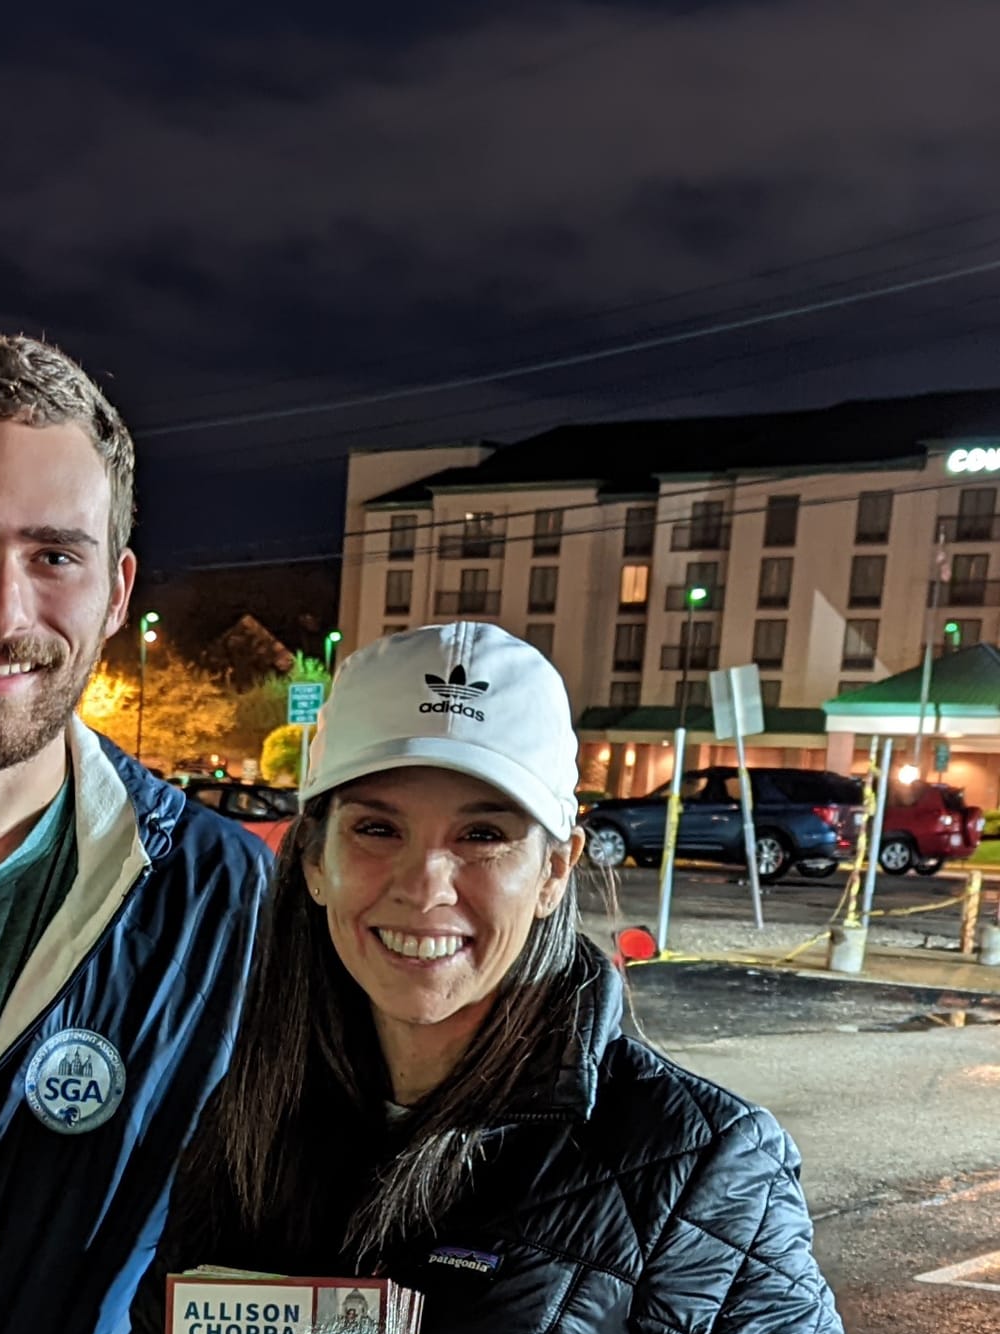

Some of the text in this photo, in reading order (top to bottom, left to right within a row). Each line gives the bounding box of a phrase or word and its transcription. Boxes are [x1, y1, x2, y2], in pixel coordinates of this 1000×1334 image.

[419, 700, 485, 722] adidas
[44, 1076, 104, 1104] SGA
[428, 1254, 488, 1272] patagonia
[184, 1301, 300, 1323] ALLISON
